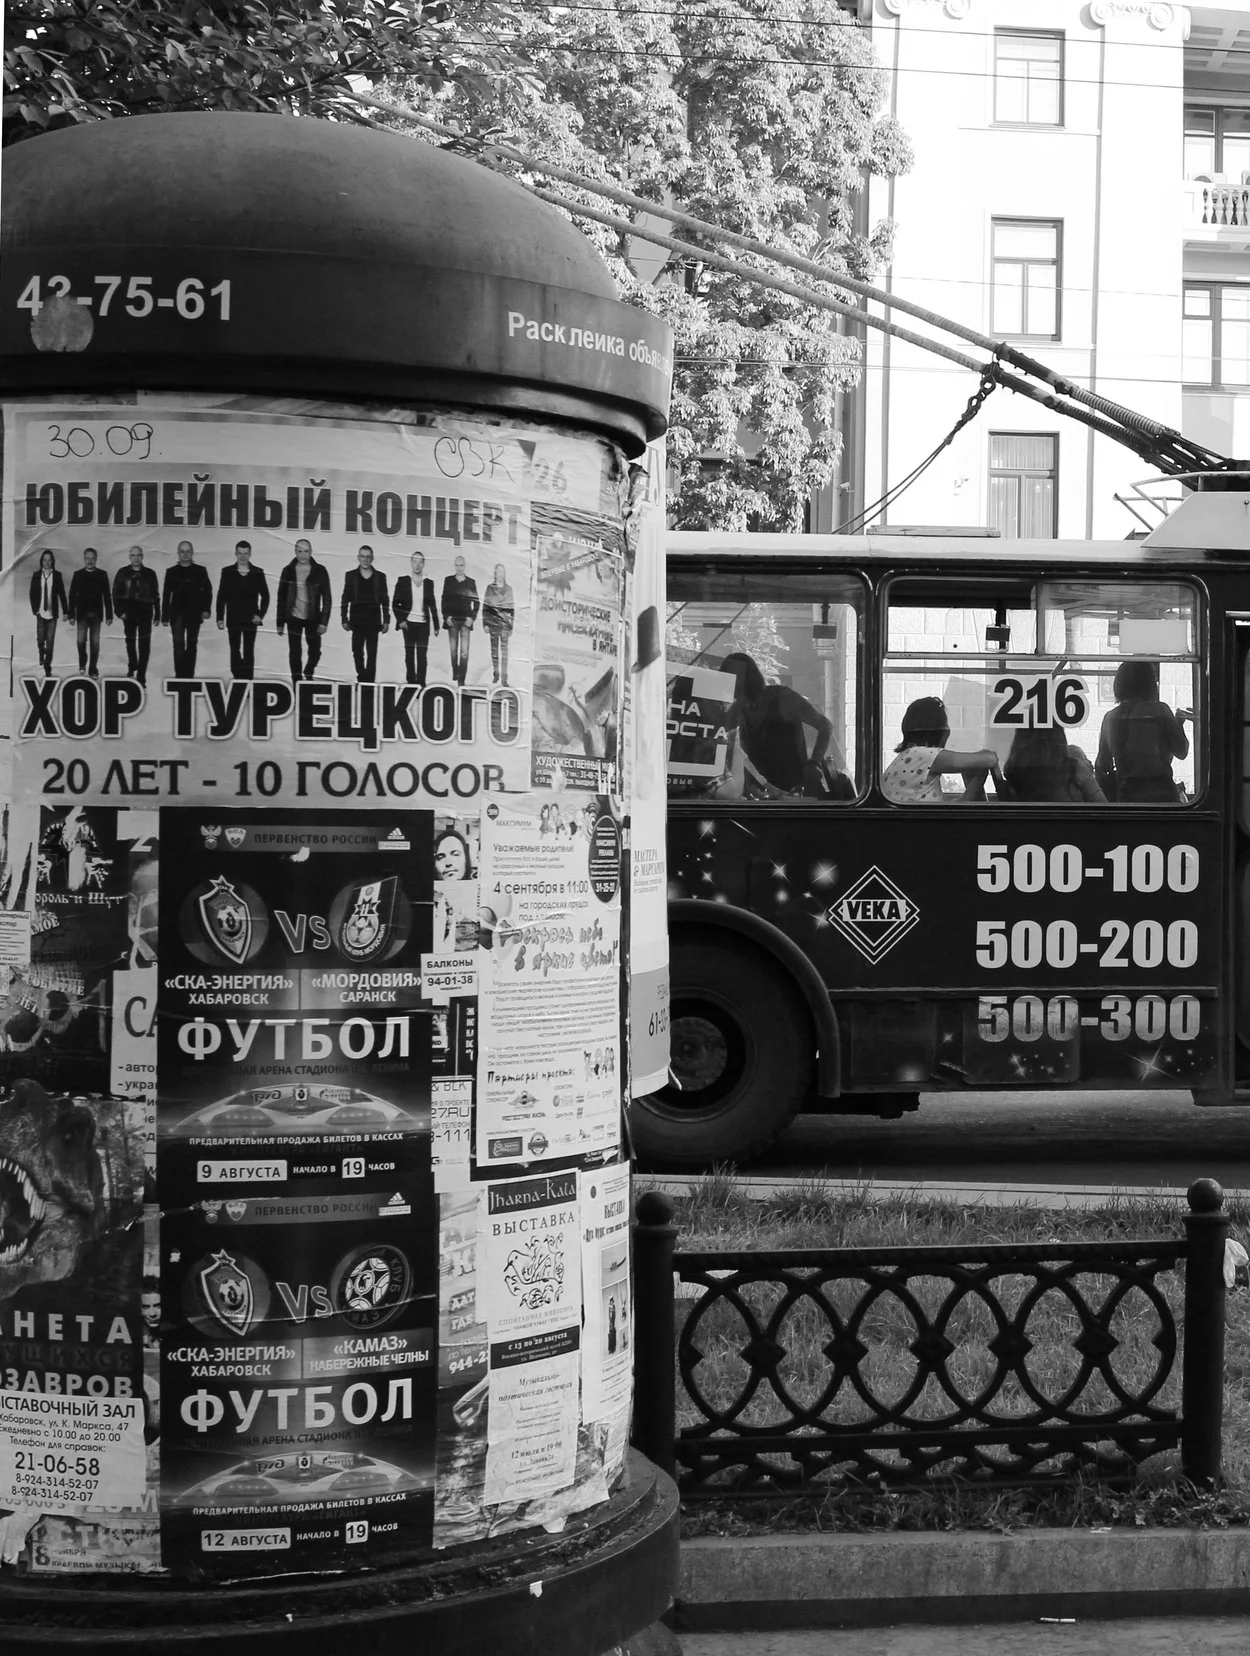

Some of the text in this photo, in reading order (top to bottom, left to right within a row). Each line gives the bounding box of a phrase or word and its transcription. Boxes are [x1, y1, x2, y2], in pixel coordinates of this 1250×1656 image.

[26, 472, 522, 545] ЮБИЛЕЙНЫЙ КОНЦЕРТ
[992, 676, 1089, 728] 216
[20, 677, 525, 751] ХОР ТУРЕЦКОГО
[666, 720, 728, 741] ОСТА
[42, 757, 91, 796] 20
[101, 758, 190, 797] ЛЕТ
[234, 760, 283, 797] 10
[296, 760, 505, 799] ГОЛОСОВ
[254, 833, 377, 845] ПЕРВЕНСТВО РОССИИ
[493, 844, 539, 852] Уважаемые
[976, 843, 1200, 893] 500-100
[36, 892, 70, 905] ороль
[493, 881, 501, 893] 4
[504, 881, 557, 896] сентября
[560, 883, 565, 893] в
[567, 881, 588, 893] 11:00
[530, 901, 566, 910] городских
[845, 900, 903, 921] VEKA
[274, 909, 332, 954] VS
[976, 920, 1199, 968] 500-200
[427, 959, 473, 968] БАЛКОНЫ
[165, 973, 422, 990] «СКА-ЭНЕРГИЯ» «МОРДОВИЯ»
[427, 976, 473, 987] 94-01-38
[188, 991, 396, 1005] ХАБАРОВСК САРАНСК
[977, 995, 1201, 1041] 500-300
[177, 1016, 411, 1062] ФУТБОЛ
[259, 1064, 348, 1077] АРЕНА СТАДИОНА
[189, 1137, 275, 1146] ПРЕДВАРИТЕЛЬНАЯ
[278, 1136, 321, 1147] ПРОДАЖА
[323, 1134, 362, 1144] БИЛЕТОВ
[372, 1132, 403, 1142] КАССАХ
[201, 1161, 396, 1179] 9 АВГУСТА НАЧАЛО В 19 ЧАСОВ
[489, 1179, 576, 1212] Jharna-Kala
[254, 1202, 377, 1217] ПЕРВЕНСТВО РОССИИ
[492, 1211, 575, 1236] ВЫСТАВКА
[275, 1281, 333, 1323] VS
[0, 1310, 133, 1345] НЕТА
[167, 1336, 408, 1363] «СКА-ЭНЕРГИЯ» «КАМАЗ»
[515, 1342, 522, 1350] 13
[544, 1332, 568, 1343] августа
[190, 1350, 429, 1377] ХАБАРОВСК НАБЕРЕЖНЫЕ ЧЕЛНЫ
[102, 1402, 136, 1419] ЗАЛ
[180, 1378, 413, 1434] ФУТБОЛ
[52, 1428, 77, 1440] 10.00
[78, 1432, 92, 1442] до
[93, 1431, 121, 1442] 20.00
[61, 1420, 70, 1429] К.
[73, 1420, 114, 1432] Маркса,
[116, 1422, 129, 1431] 47
[9, 1435, 106, 1452] Телефон для справок:
[261, 1434, 295, 1445] АРЕНА
[297, 1431, 350, 1444] СТАДИОНА
[14, 1452, 100, 1476] 21-06-58
[16, 1473, 99, 1490] 8-924-314-52-07
[11, 1485, 93, 1502] 8-924-314-52-07
[193, 1505, 278, 1516] ПРЕДВАРИТЕЛЬНАЯ
[281, 1502, 324, 1513] ПРОДАЖА
[326, 1499, 365, 1509] БИЛЕТОВ
[375, 1493, 406, 1504] КАССАХ
[203, 1523, 398, 1546] 12 АВГУСТА НАЧАЛО В 19 ЧАСОВ
[35, 1545, 50, 1566] 8
